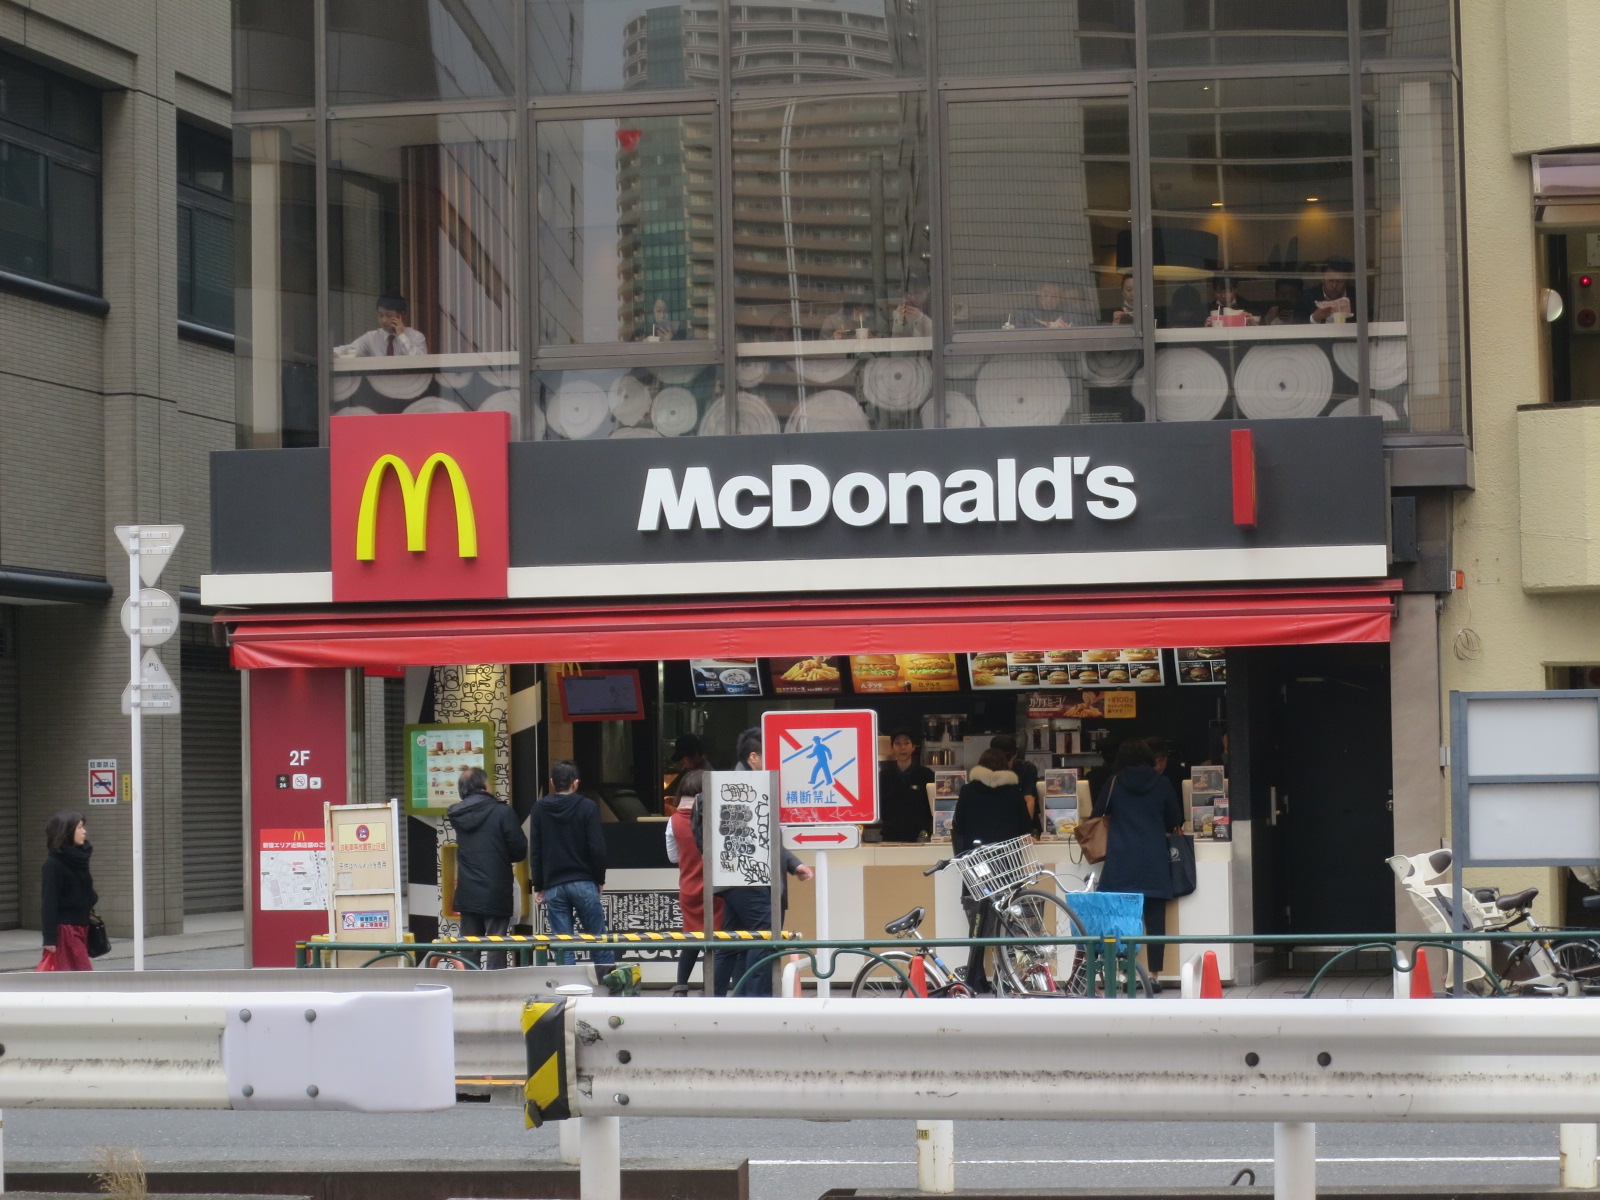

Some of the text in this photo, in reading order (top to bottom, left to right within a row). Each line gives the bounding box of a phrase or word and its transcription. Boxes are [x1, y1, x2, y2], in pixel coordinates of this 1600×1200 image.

[637, 455, 1138, 532] McDonald's
[289, 750, 310, 766] 2F
[786, 790, 837, 804] 横断禁止
[672, 898, 683, 928] HAPPY
